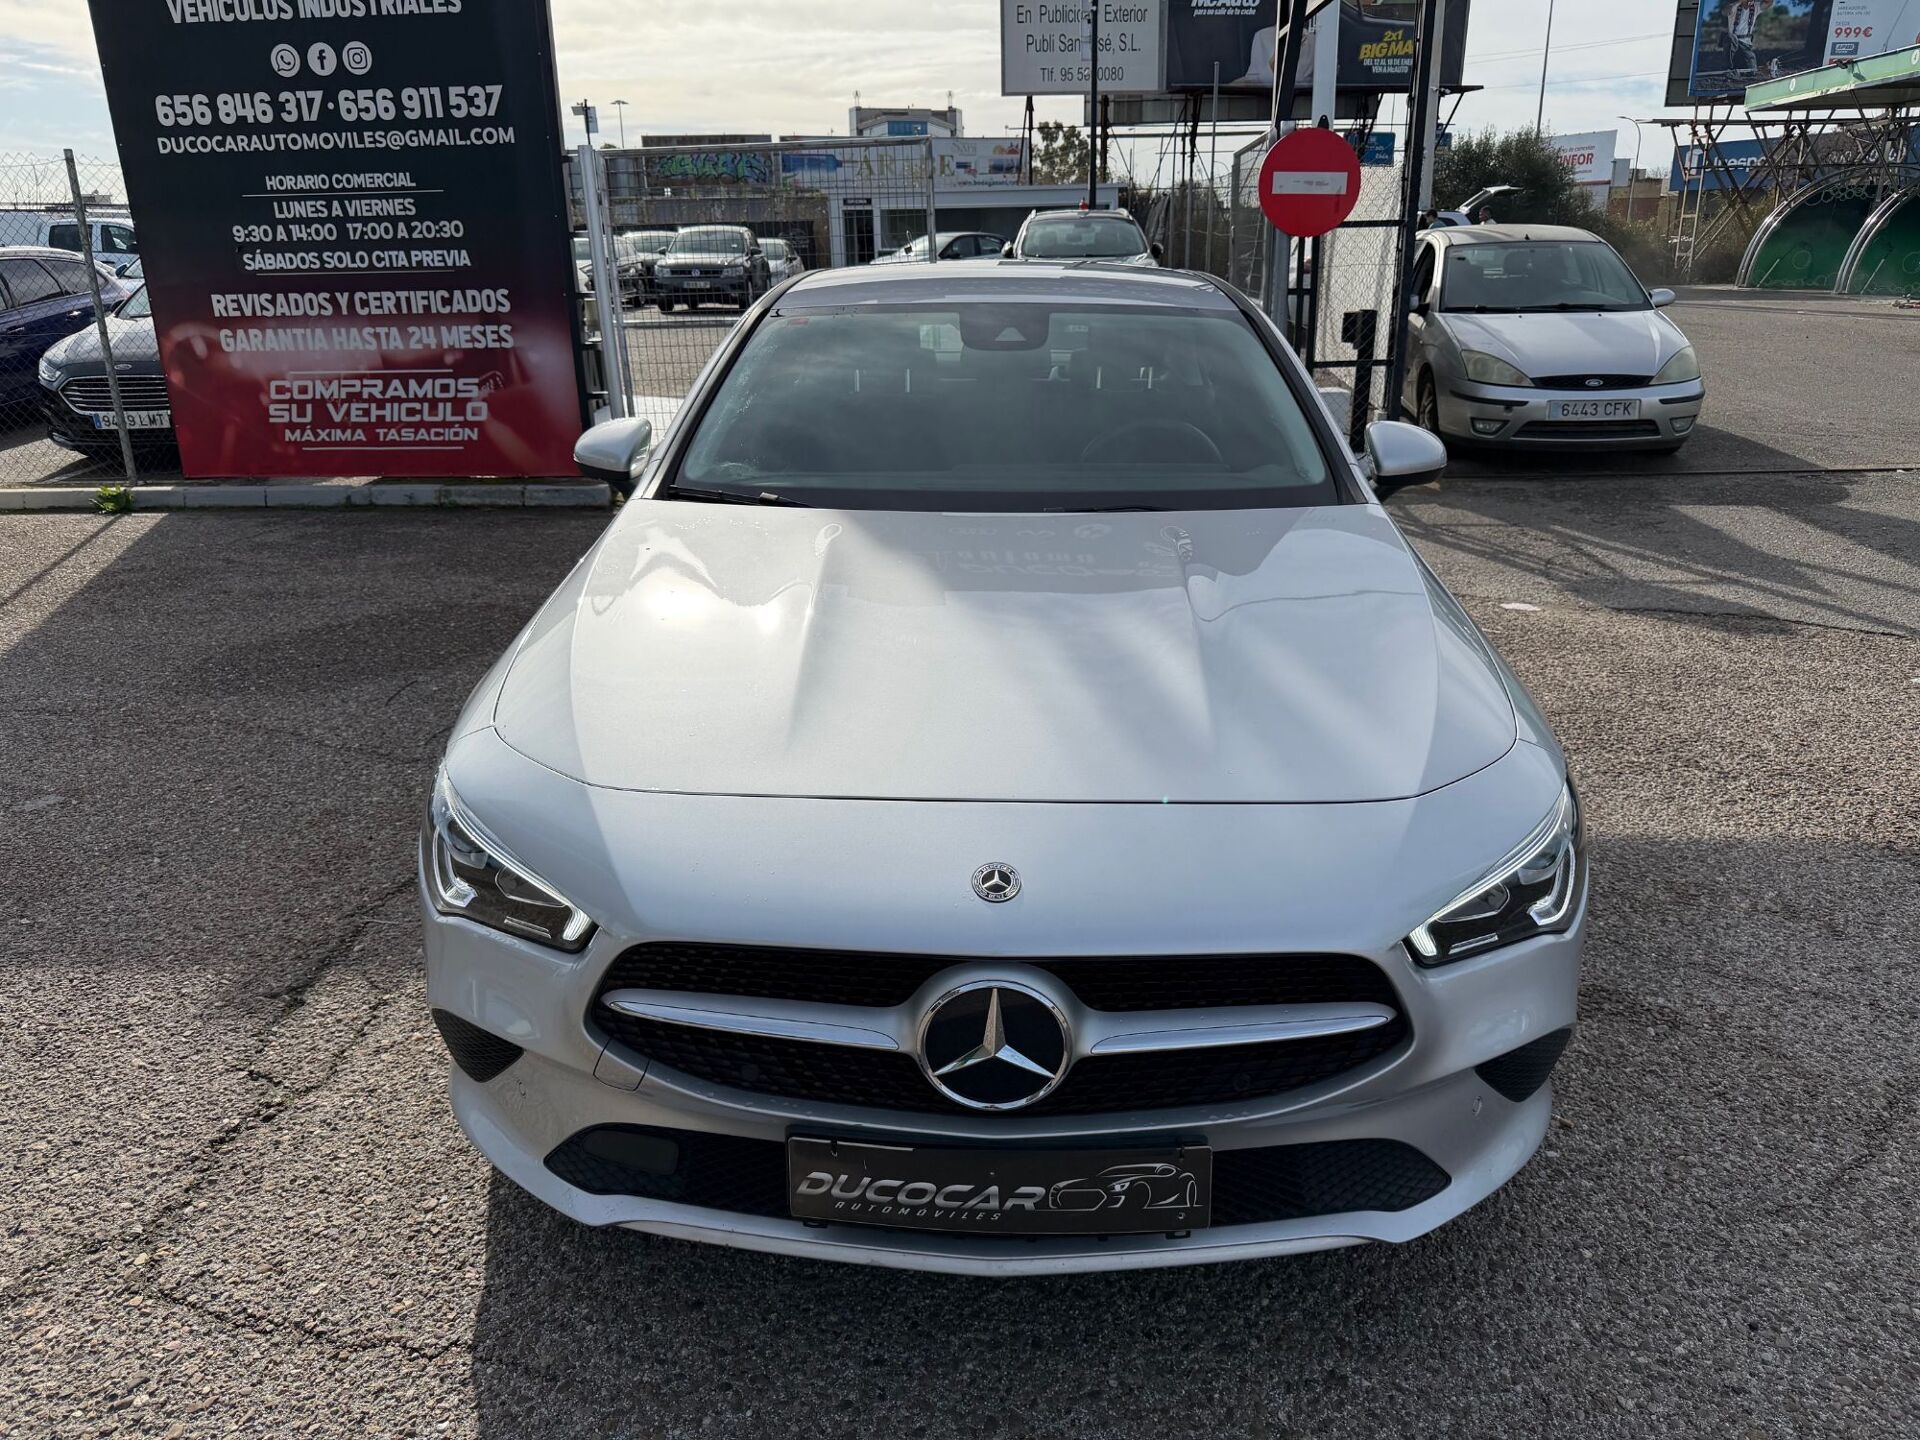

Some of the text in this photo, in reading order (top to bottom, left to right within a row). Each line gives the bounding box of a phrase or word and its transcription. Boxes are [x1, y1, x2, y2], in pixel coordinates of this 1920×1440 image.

[298, 0, 462, 18] INDUSTRIALES
[1016, 5, 1032, 24] En
[1104, 4, 1148, 23] Exterior
[1026, 34, 1055, 53] Publi
[1058, 33, 1081, 53] San
[1118, 32, 1141, 52] S.L.
[1383, 29, 1404, 41] 2x1
[1834, 26, 1873, 38] 999€
[1359, 40, 1415, 59] BIG MA
[1040, 67, 1057, 82] Tlf.
[1060, 67, 1073, 82] 95
[155, 84, 503, 126] 656 846 317 656 911 537
[157, 127, 516, 154] DUCOCARAUTOMOVILES@GMAIL.COM
[265, 172, 416, 191] HORARIO COMERCIAL
[273, 198, 417, 219] LUNES A VIERNES
[232, 220, 464, 242] 9:30 A 14:00 17:00 A 20:30
[242, 249, 472, 271] SÁBADOS SOLO CITA PREVIA
[211, 288, 511, 317] REVISADOS Y CERTIFICADOS
[219, 324, 514, 352] GARANTIA HASTA 24 MESES
[269, 377, 480, 400] COMPRAMOS
[102, 413, 164, 427] 949 LMT
[269, 401, 488, 423] SU VEHICULO
[1561, 402, 1632, 417] 6443 CFK
[284, 424, 479, 442] MÁXIMA TASACIÓN
[796, 1171, 1047, 1211] DUCOCAR
